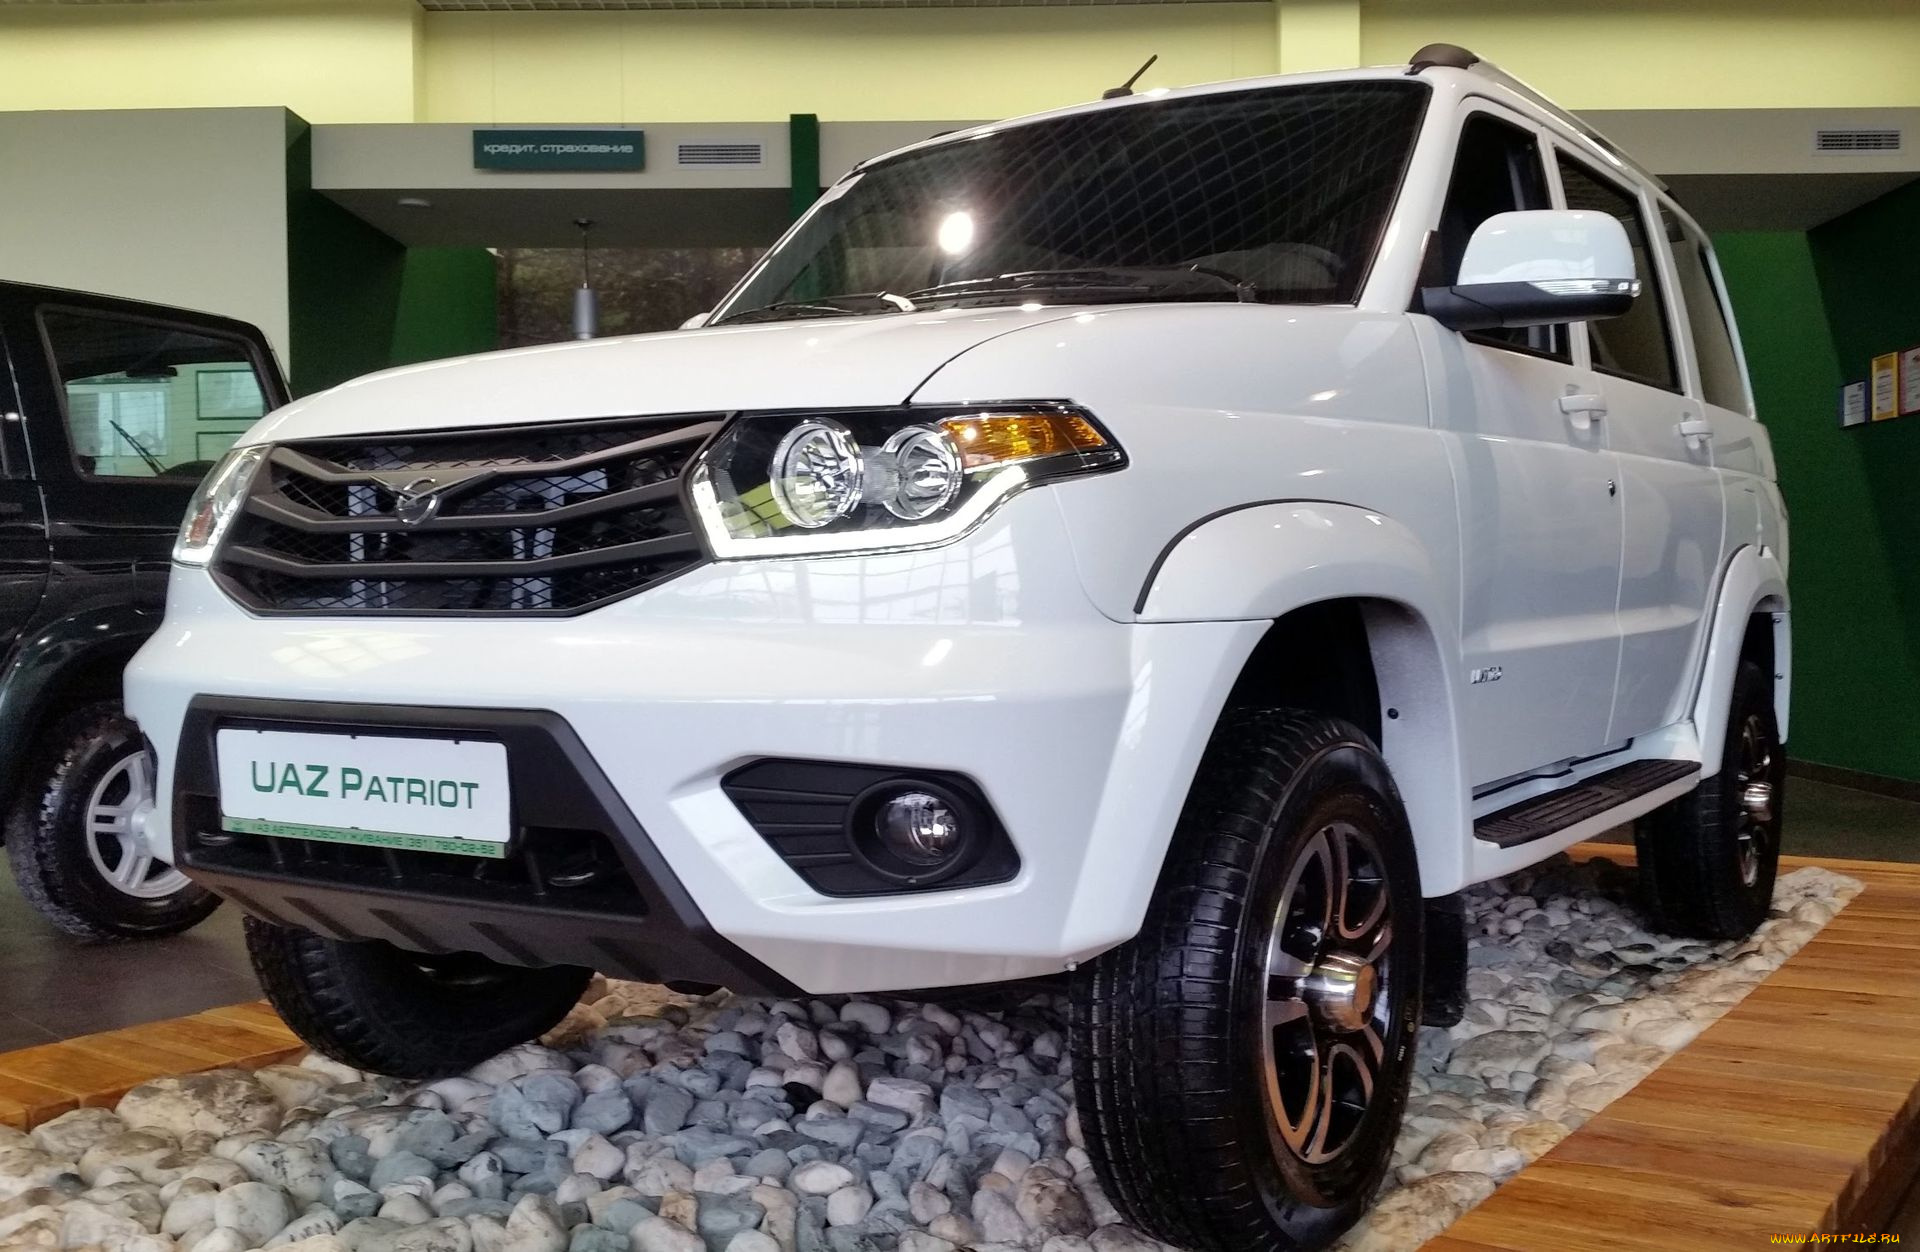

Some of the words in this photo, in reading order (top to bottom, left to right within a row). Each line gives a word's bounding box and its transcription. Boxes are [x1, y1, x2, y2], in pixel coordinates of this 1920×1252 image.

[483, 144, 538, 155] кредит,
[540, 144, 634, 155] страхование
[251, 760, 329, 798] UAZ
[340, 767, 480, 809] PATRIOT
